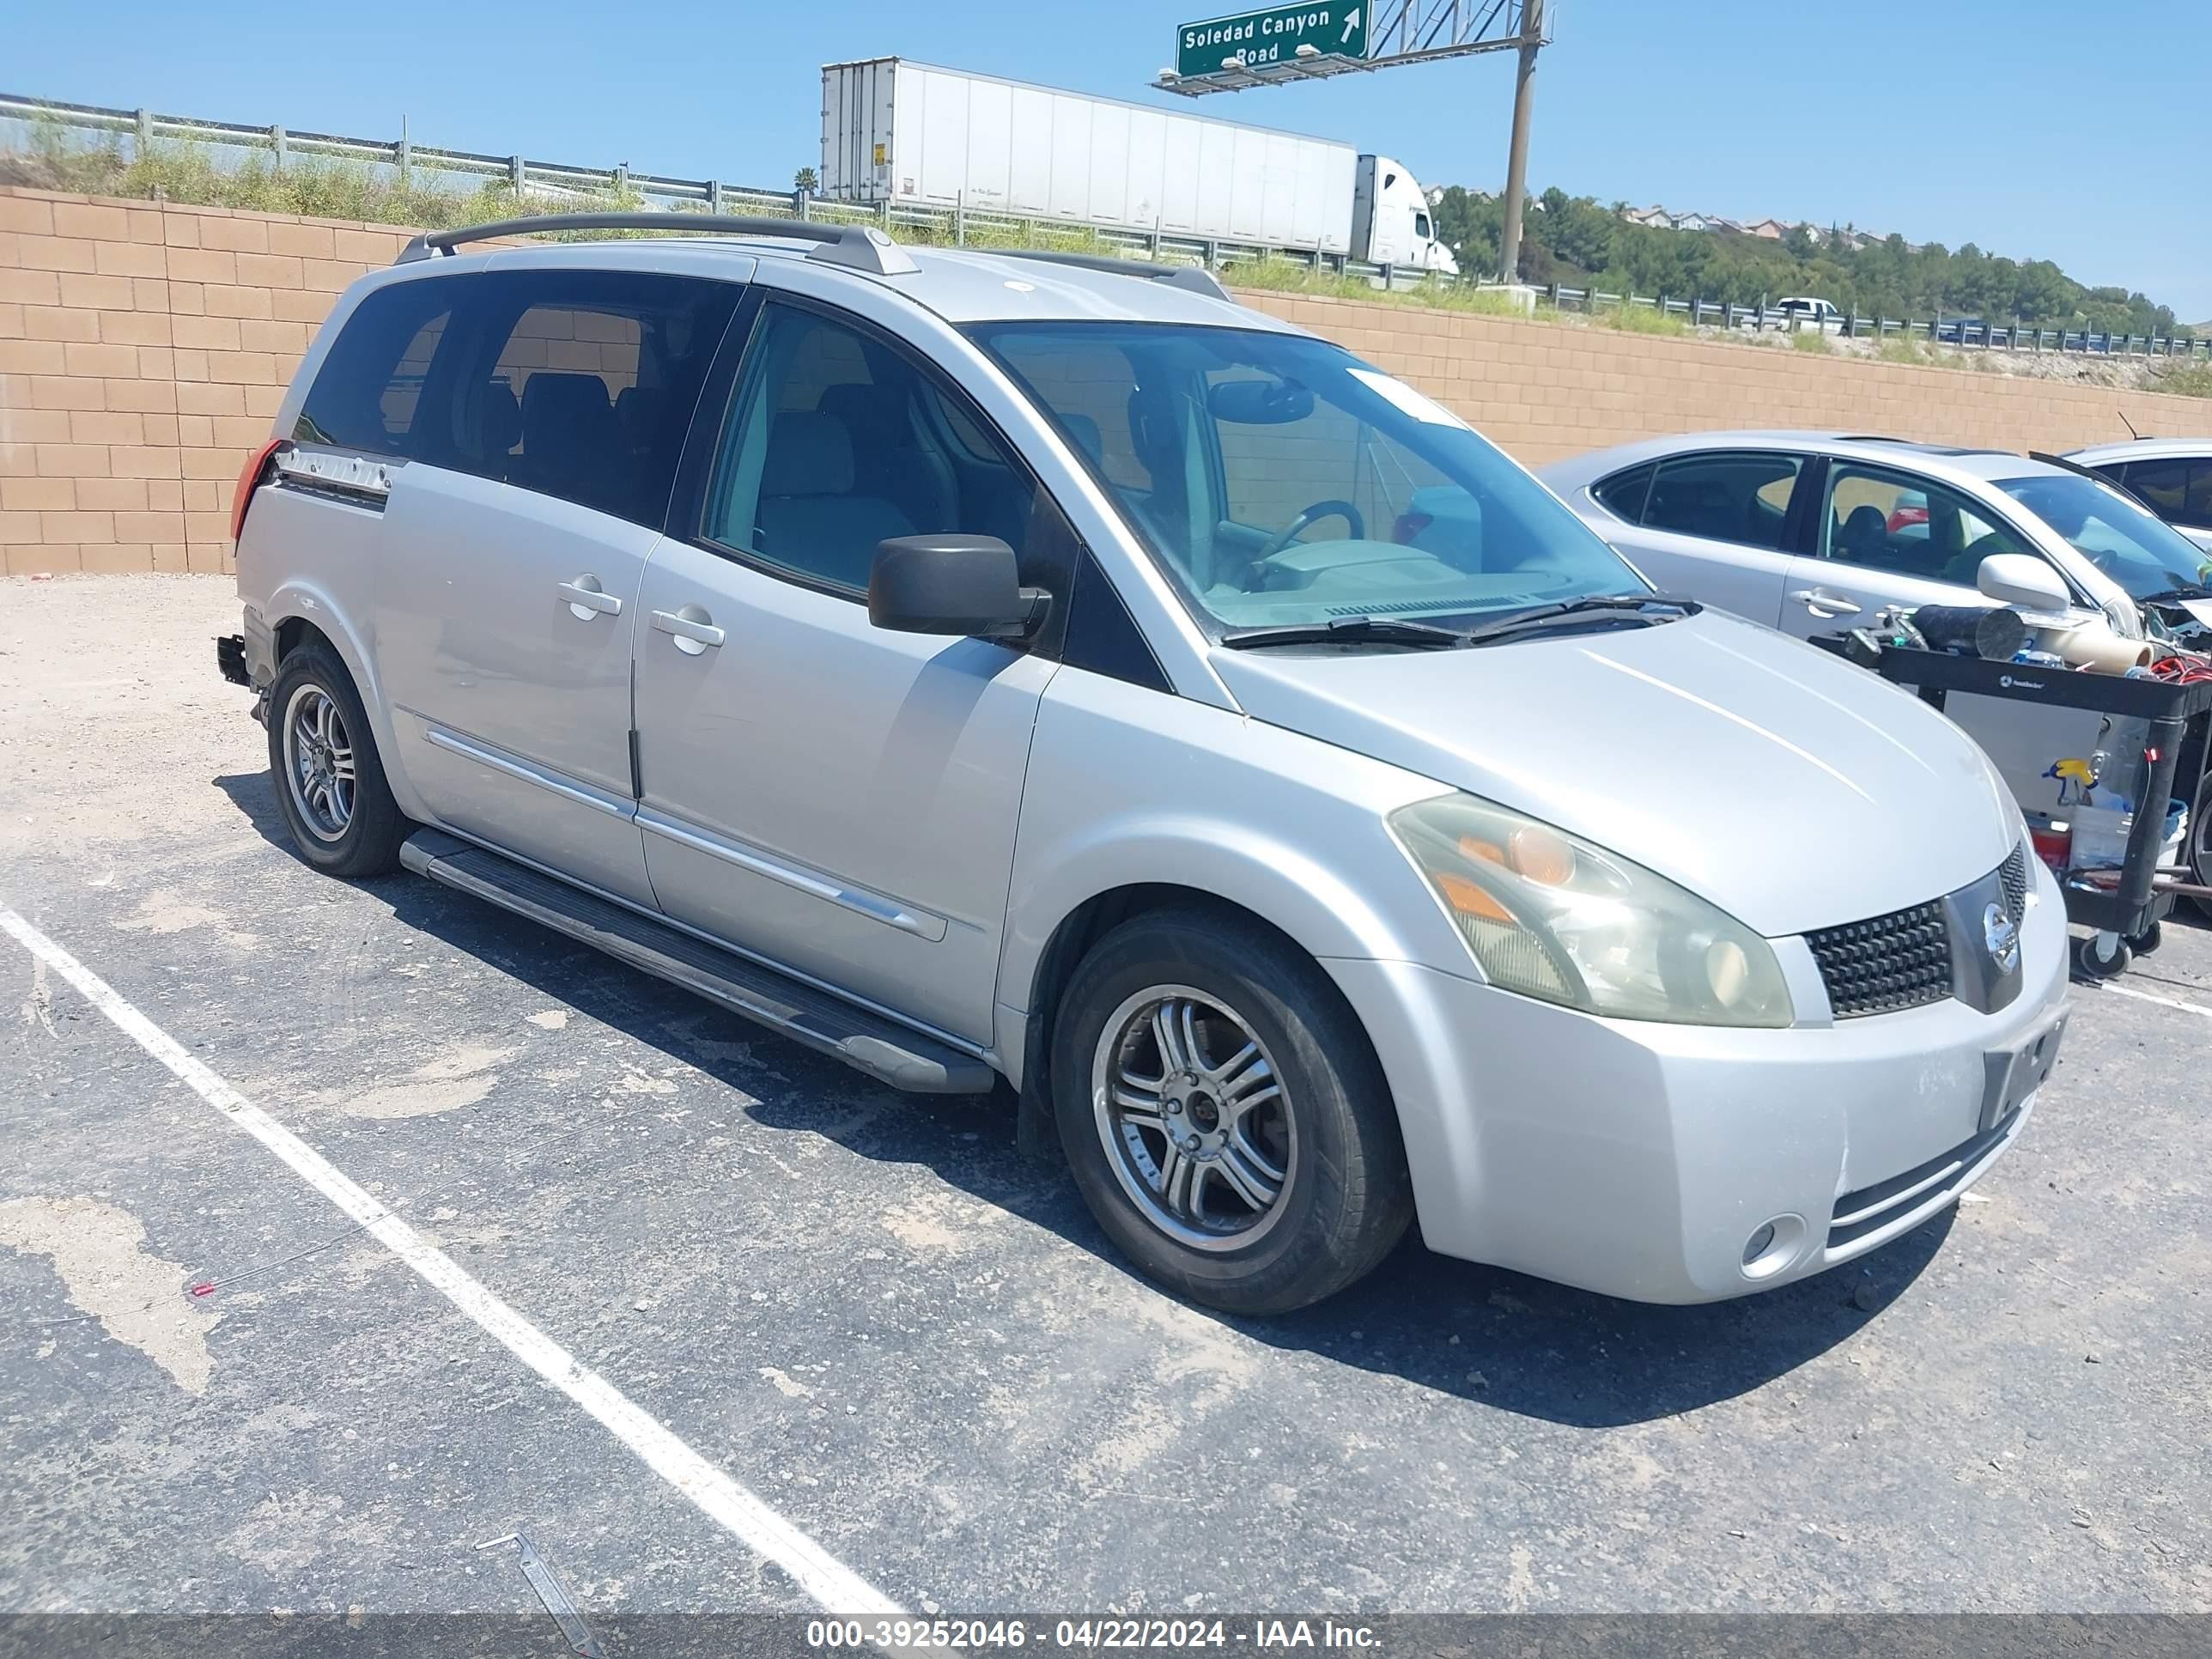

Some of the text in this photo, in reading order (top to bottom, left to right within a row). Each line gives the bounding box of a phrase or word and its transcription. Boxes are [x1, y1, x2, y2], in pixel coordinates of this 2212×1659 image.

[1185, 10, 1329, 49] Soledad Canyon
[1237, 42, 1279, 65] Road
